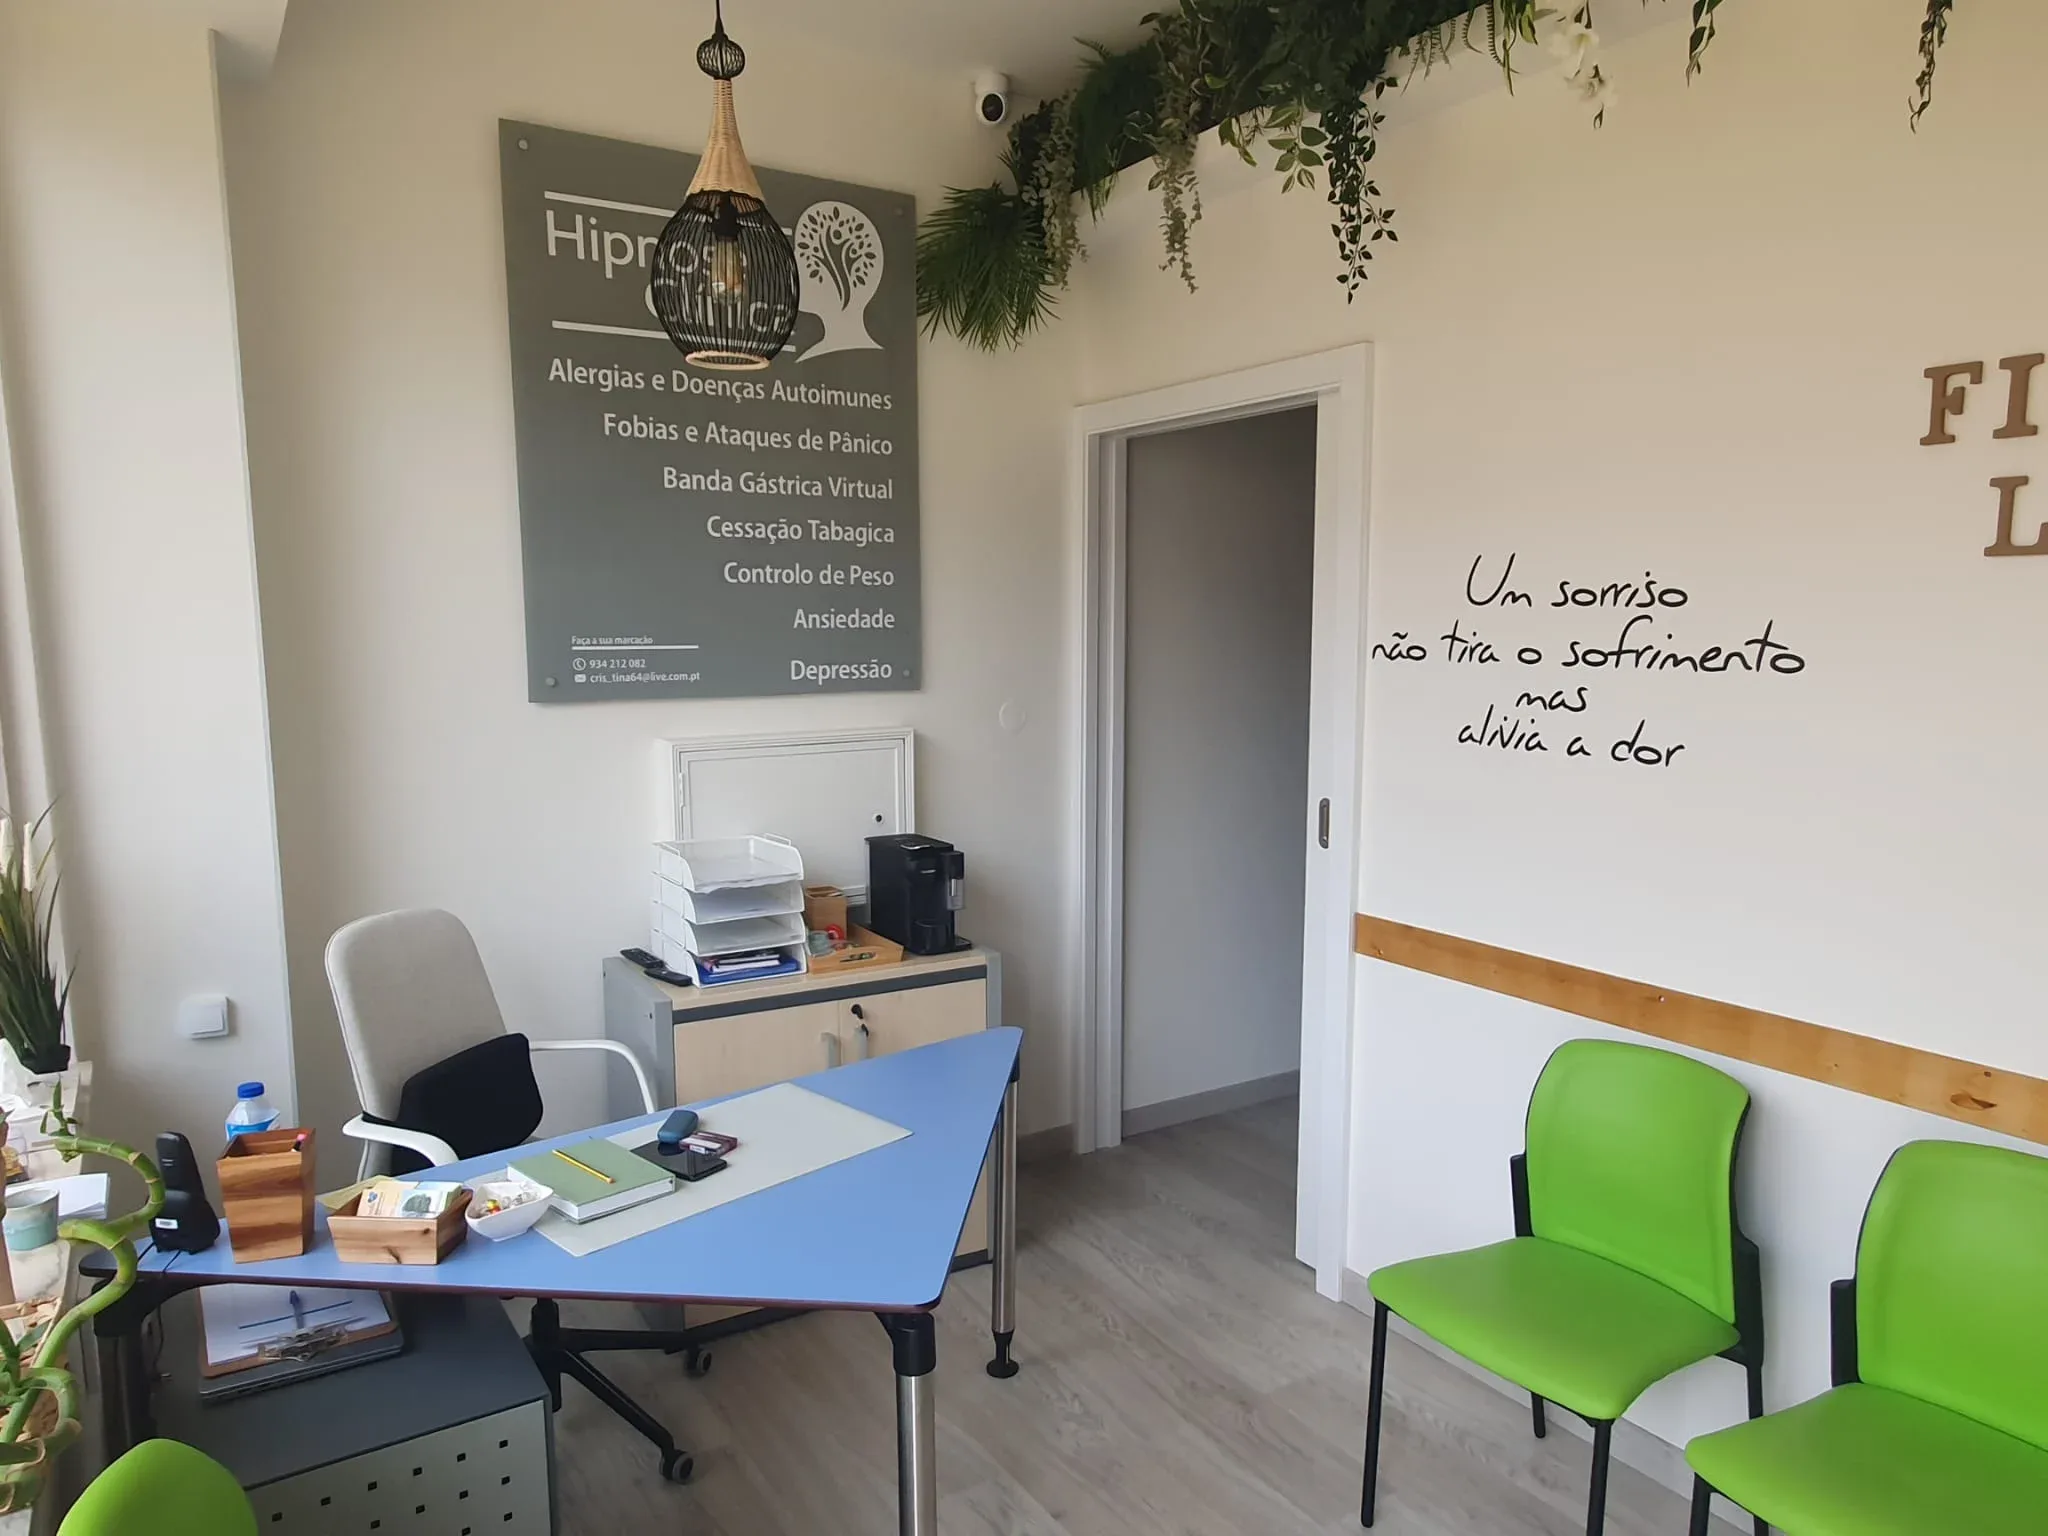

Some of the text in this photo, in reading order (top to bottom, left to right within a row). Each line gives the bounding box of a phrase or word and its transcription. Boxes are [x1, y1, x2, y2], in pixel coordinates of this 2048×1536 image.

[548, 358, 892, 410] Alergias e Doenças Autoimunes
[603, 413, 893, 455] Fobias e Ataques de Pânico
[663, 466, 893, 500] Banda Gástrica Virtual
[707, 515, 894, 547] Cessação Tabagica
[723, 561, 894, 586] Controlo de Peso
[1466, 552, 1689, 608] Um sorriso
[793, 607, 895, 629] Ansiedade
[1371, 614, 1806, 674] não tira o sofrimento
[589, 658, 646, 669] 934 212 082
[790, 659, 892, 686] Depressão
[1515, 686, 1588, 713] mas
[1457, 704, 1685, 767] alivia a dor
